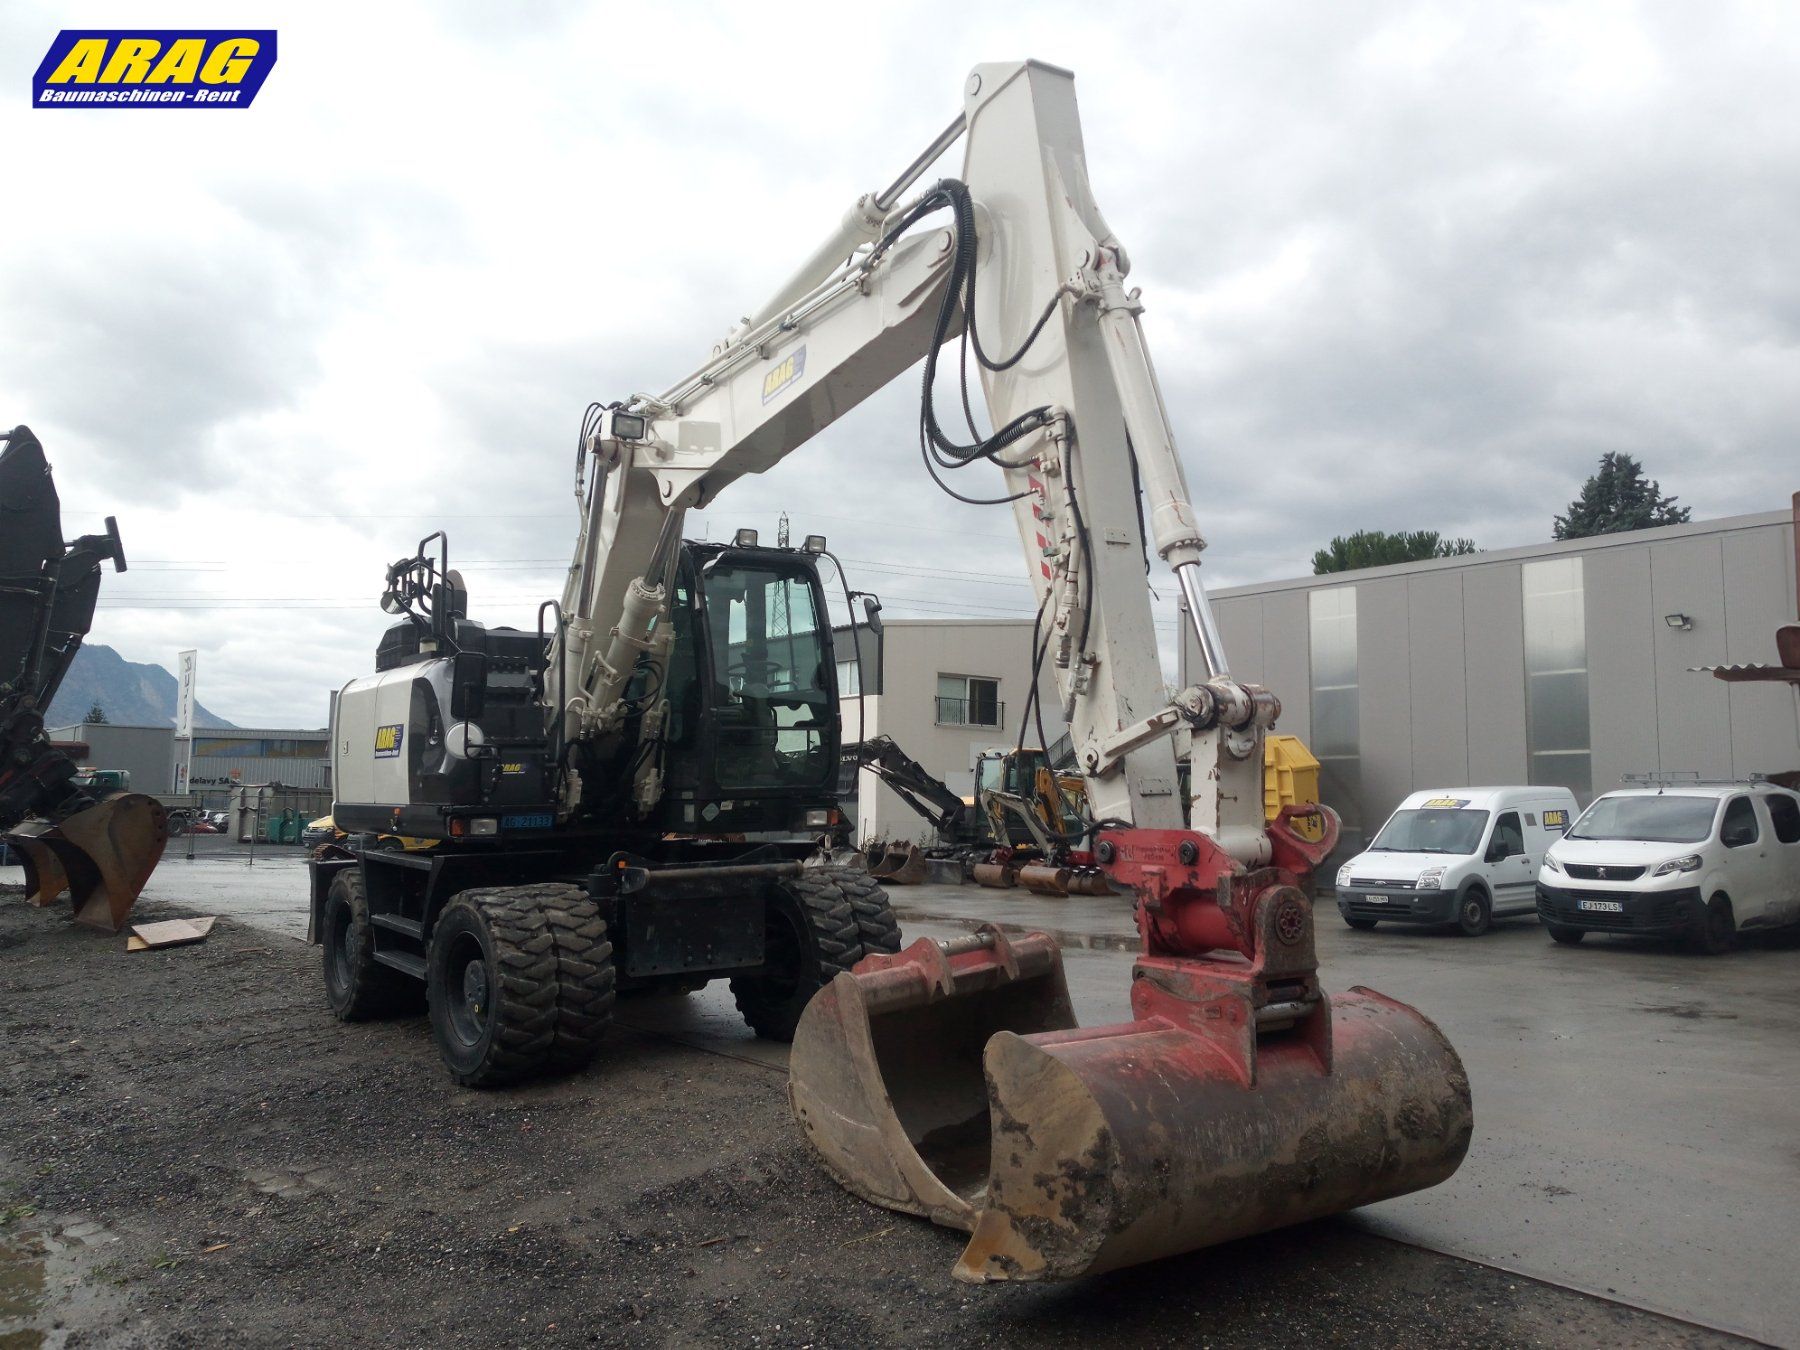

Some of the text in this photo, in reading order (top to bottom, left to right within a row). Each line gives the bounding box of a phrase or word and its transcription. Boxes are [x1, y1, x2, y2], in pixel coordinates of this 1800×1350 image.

[764, 355, 794, 397] ARAG
[376, 727, 396, 749] ARAG
[1544, 811, 1563, 825] ARAG
